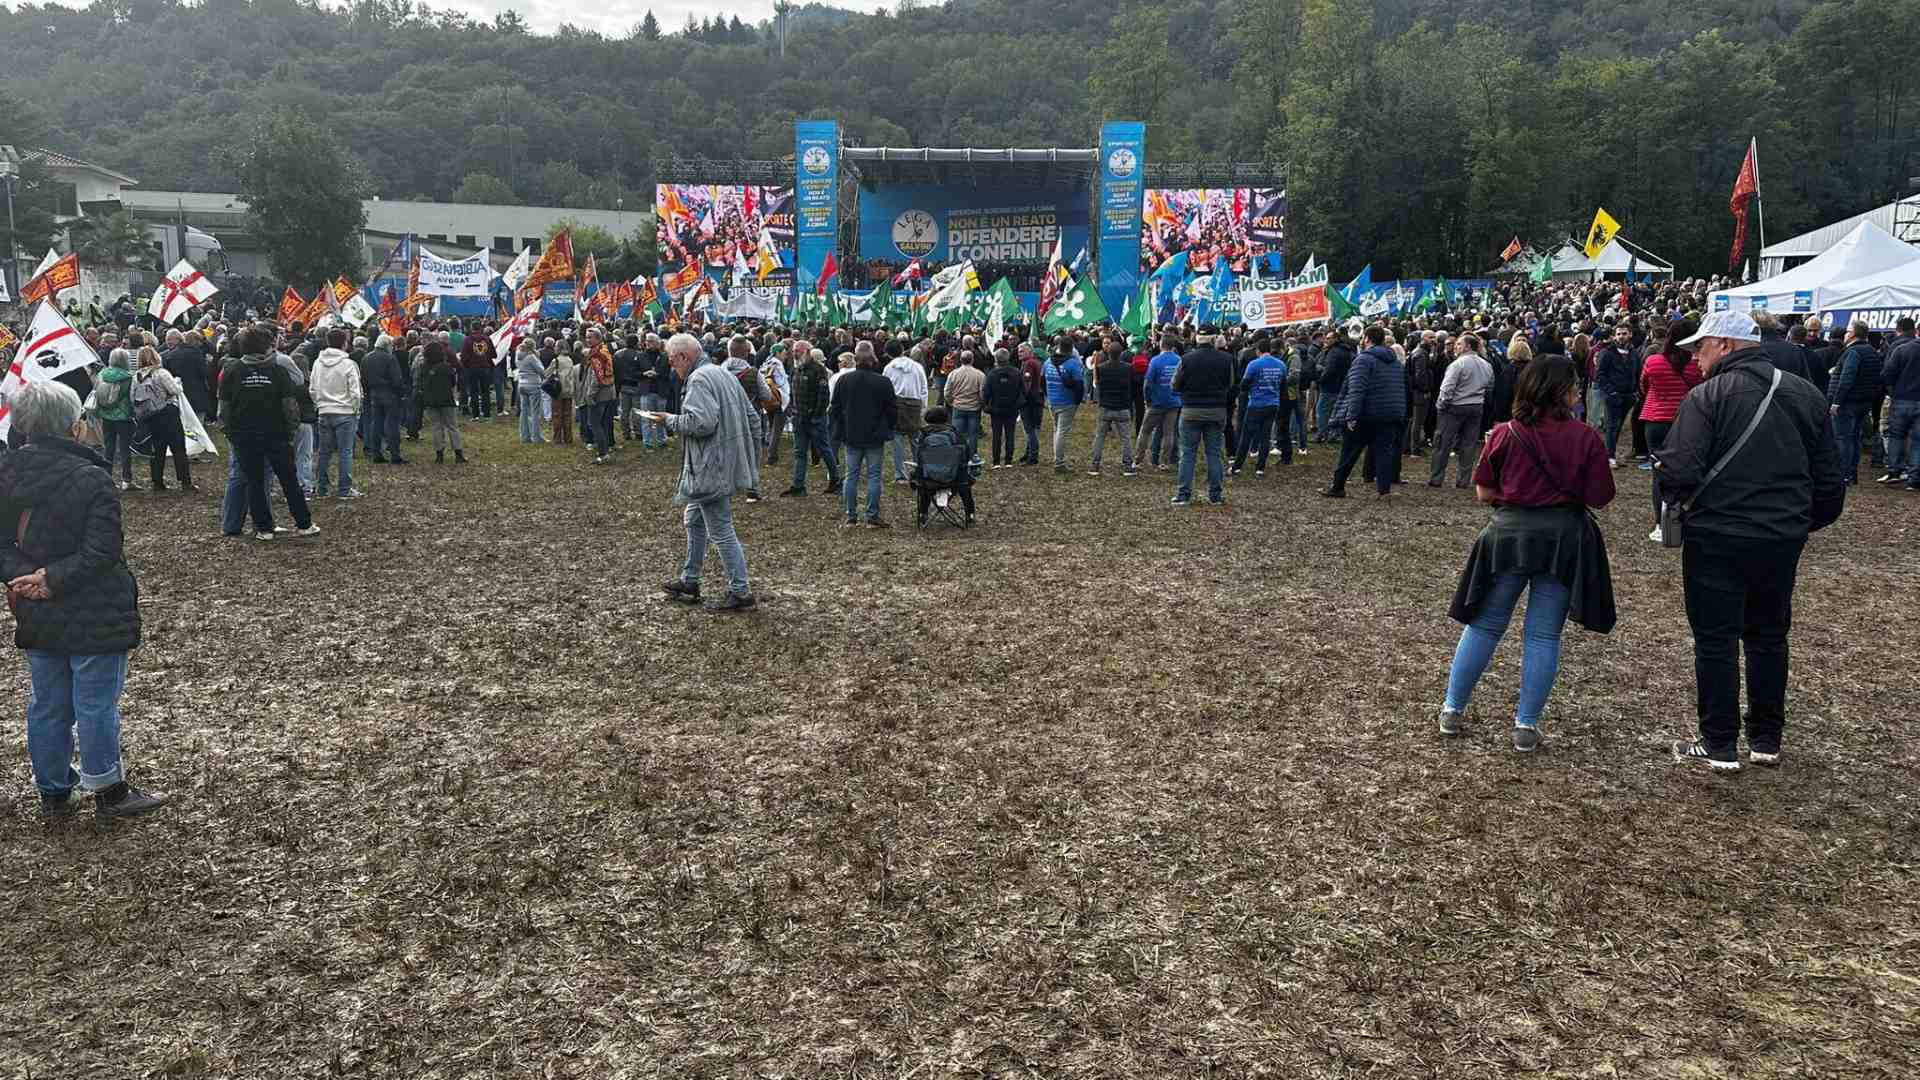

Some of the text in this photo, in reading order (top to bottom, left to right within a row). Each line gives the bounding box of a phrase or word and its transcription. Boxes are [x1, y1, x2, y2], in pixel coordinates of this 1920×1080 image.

[897, 213, 931, 229] LEGA
[948, 217, 977, 230] NON
[991, 215, 1010, 227] UN
[1014, 213, 1056, 226] REATO
[948, 225, 1057, 246] DIFENDERE
[957, 242, 1037, 262] CONFINI
